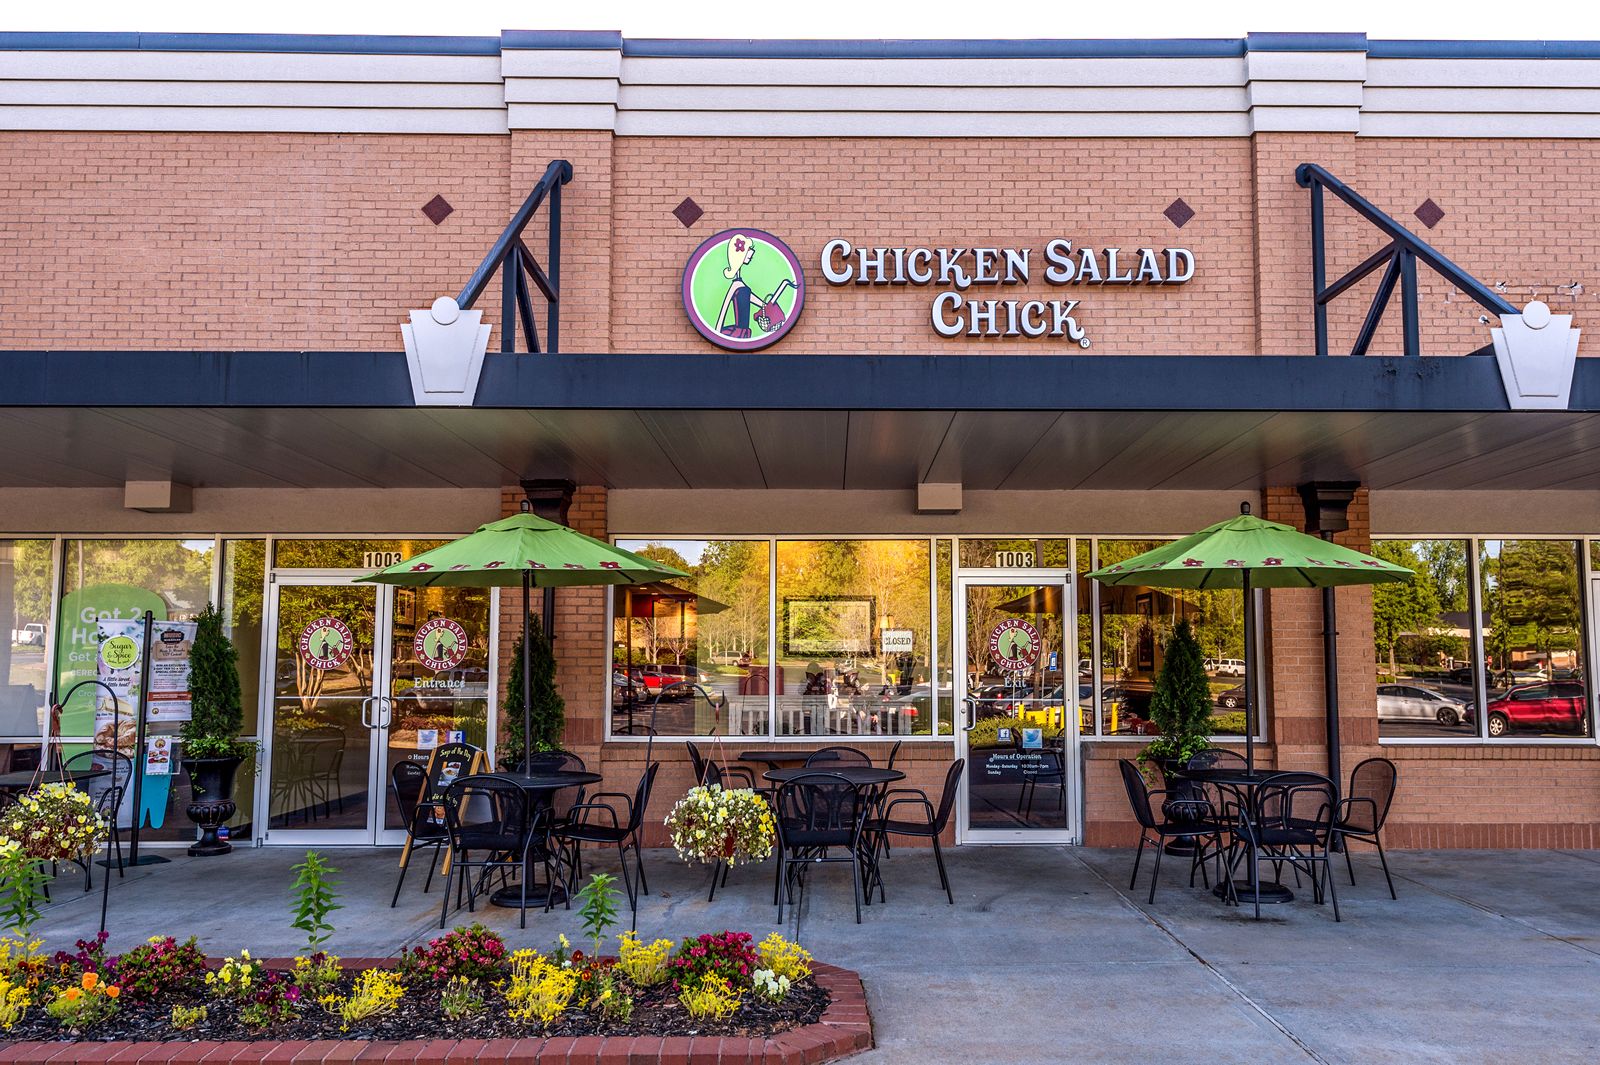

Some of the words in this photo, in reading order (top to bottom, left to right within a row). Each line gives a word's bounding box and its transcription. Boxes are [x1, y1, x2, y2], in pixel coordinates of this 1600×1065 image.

[820, 239, 1032, 291] CHICKEN
[1043, 238, 1195, 286] SALAD
[931, 291, 1085, 343] CHICK
[365, 552, 402, 567] 1003
[998, 552, 1033, 567] 1003
[301, 619, 332, 651] CHICKEN
[334, 621, 351, 650] SALAD
[415, 620, 446, 652] CHICKEN
[448, 622, 466, 651] SALAD
[884, 637, 911, 645] CLOSED
[990, 620, 1019, 651] CHICKEN
[1021, 622, 1039, 651] SALAD
[110, 640, 132, 653] Sugar
[68, 651, 91, 662] Get
[113, 650, 131, 664] Spice
[310, 658, 340, 669] CHICK
[425, 659, 455, 670] CHICK
[1000, 659, 1030, 669] CHICK
[413, 677, 465, 688] Entrance
[1004, 677, 1026, 688] Exit
